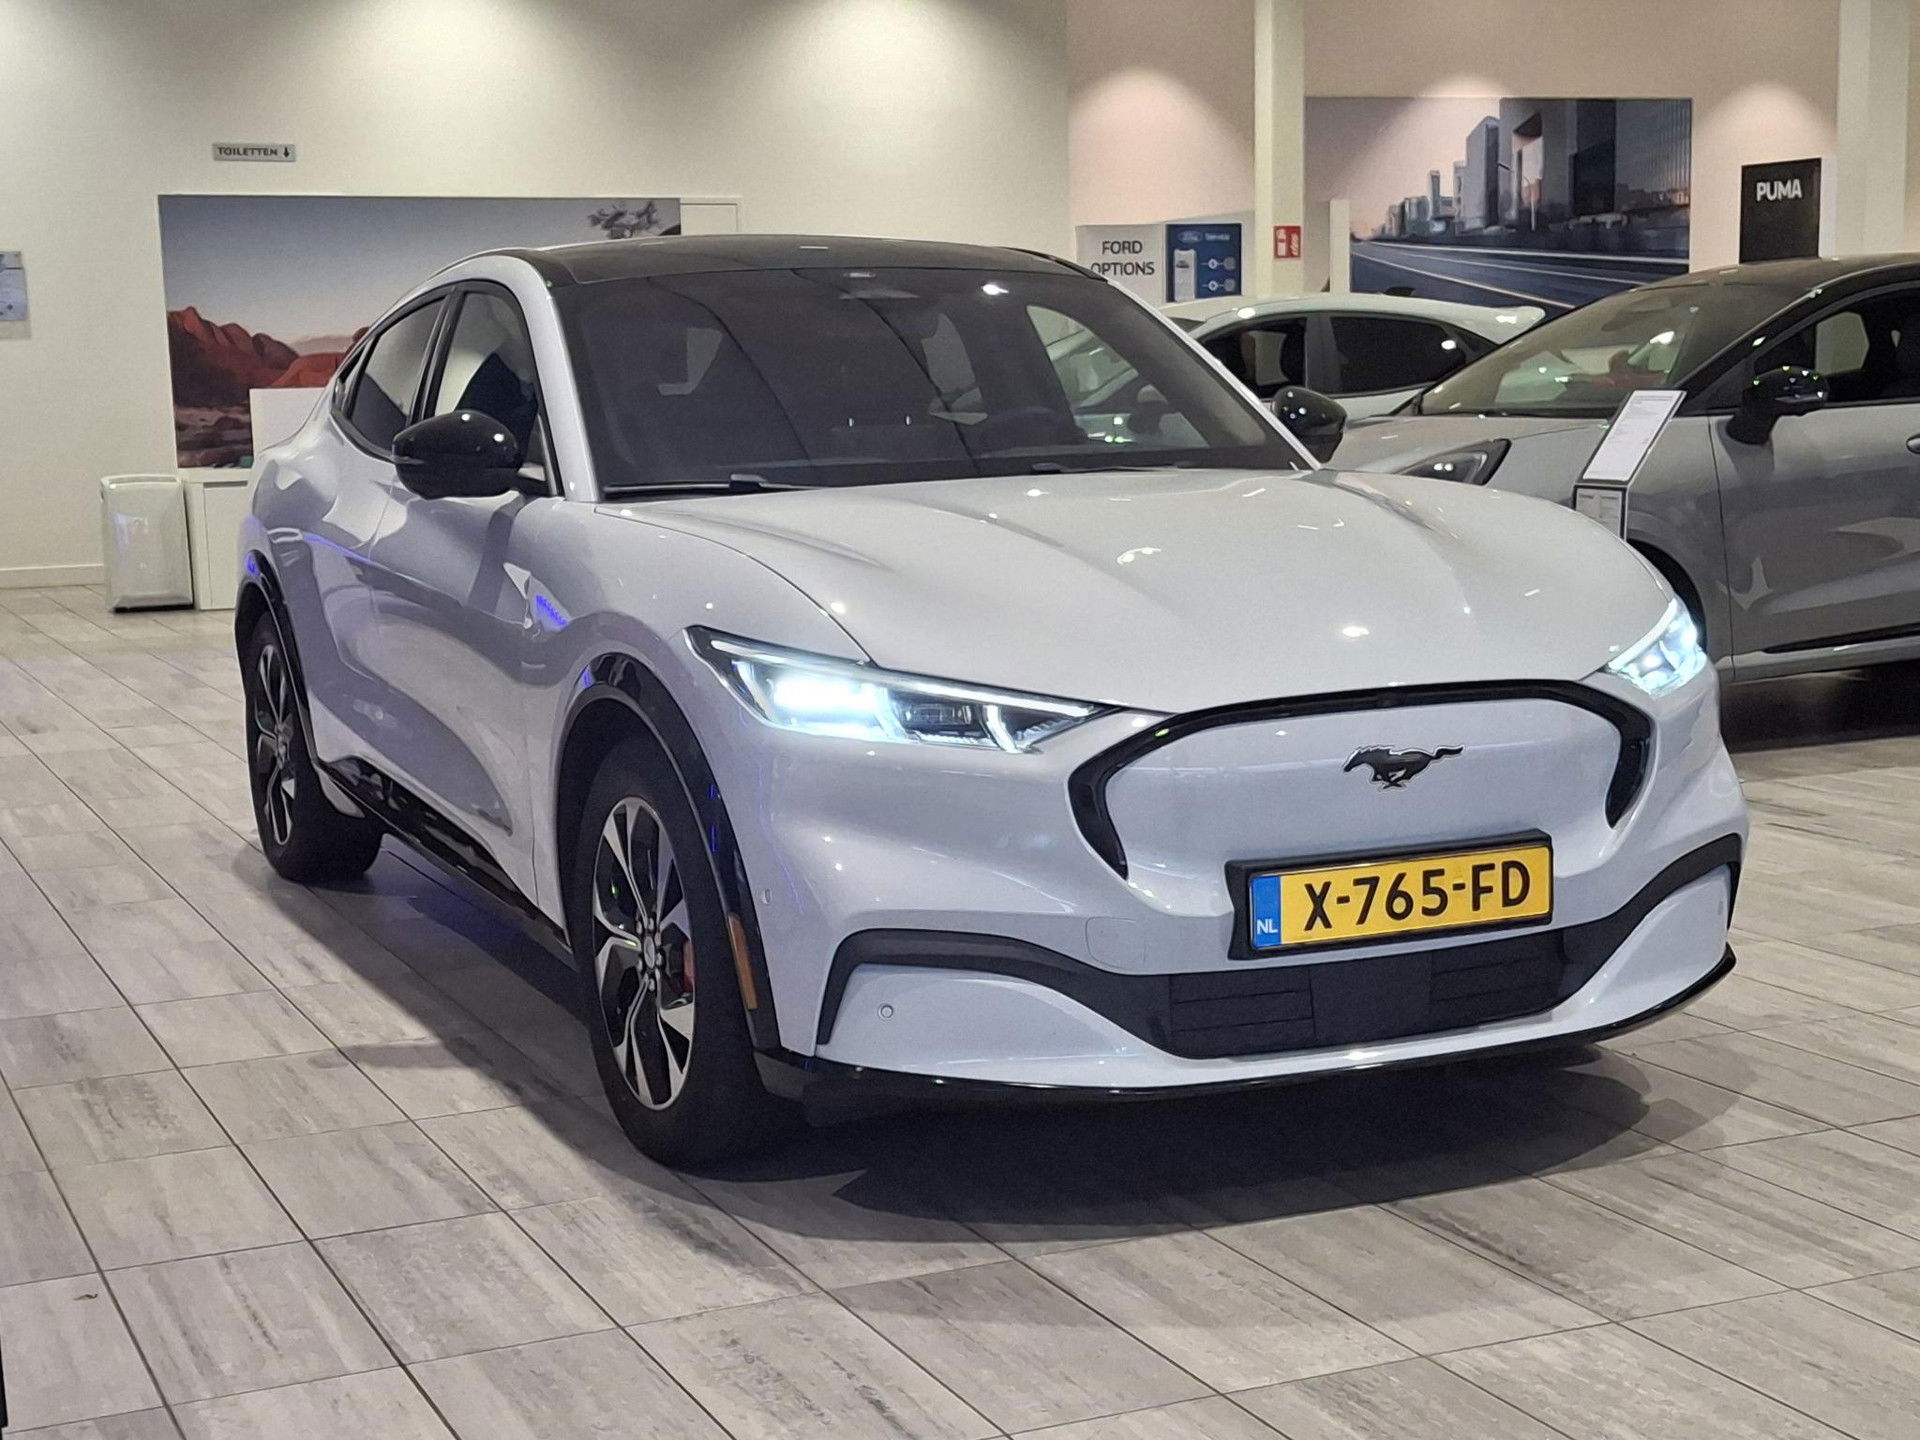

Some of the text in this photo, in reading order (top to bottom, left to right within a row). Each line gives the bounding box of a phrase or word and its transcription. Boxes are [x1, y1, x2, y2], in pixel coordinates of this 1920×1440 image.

[217, 146, 278, 156] TOILETTEN
[1756, 179, 1802, 202] PUMA
[1102, 240, 1143, 255] FORD
[1090, 262, 1155, 276] OPTIONS
[1304, 860, 1530, 931] X-765-FD
[1256, 918, 1278, 935] NL
